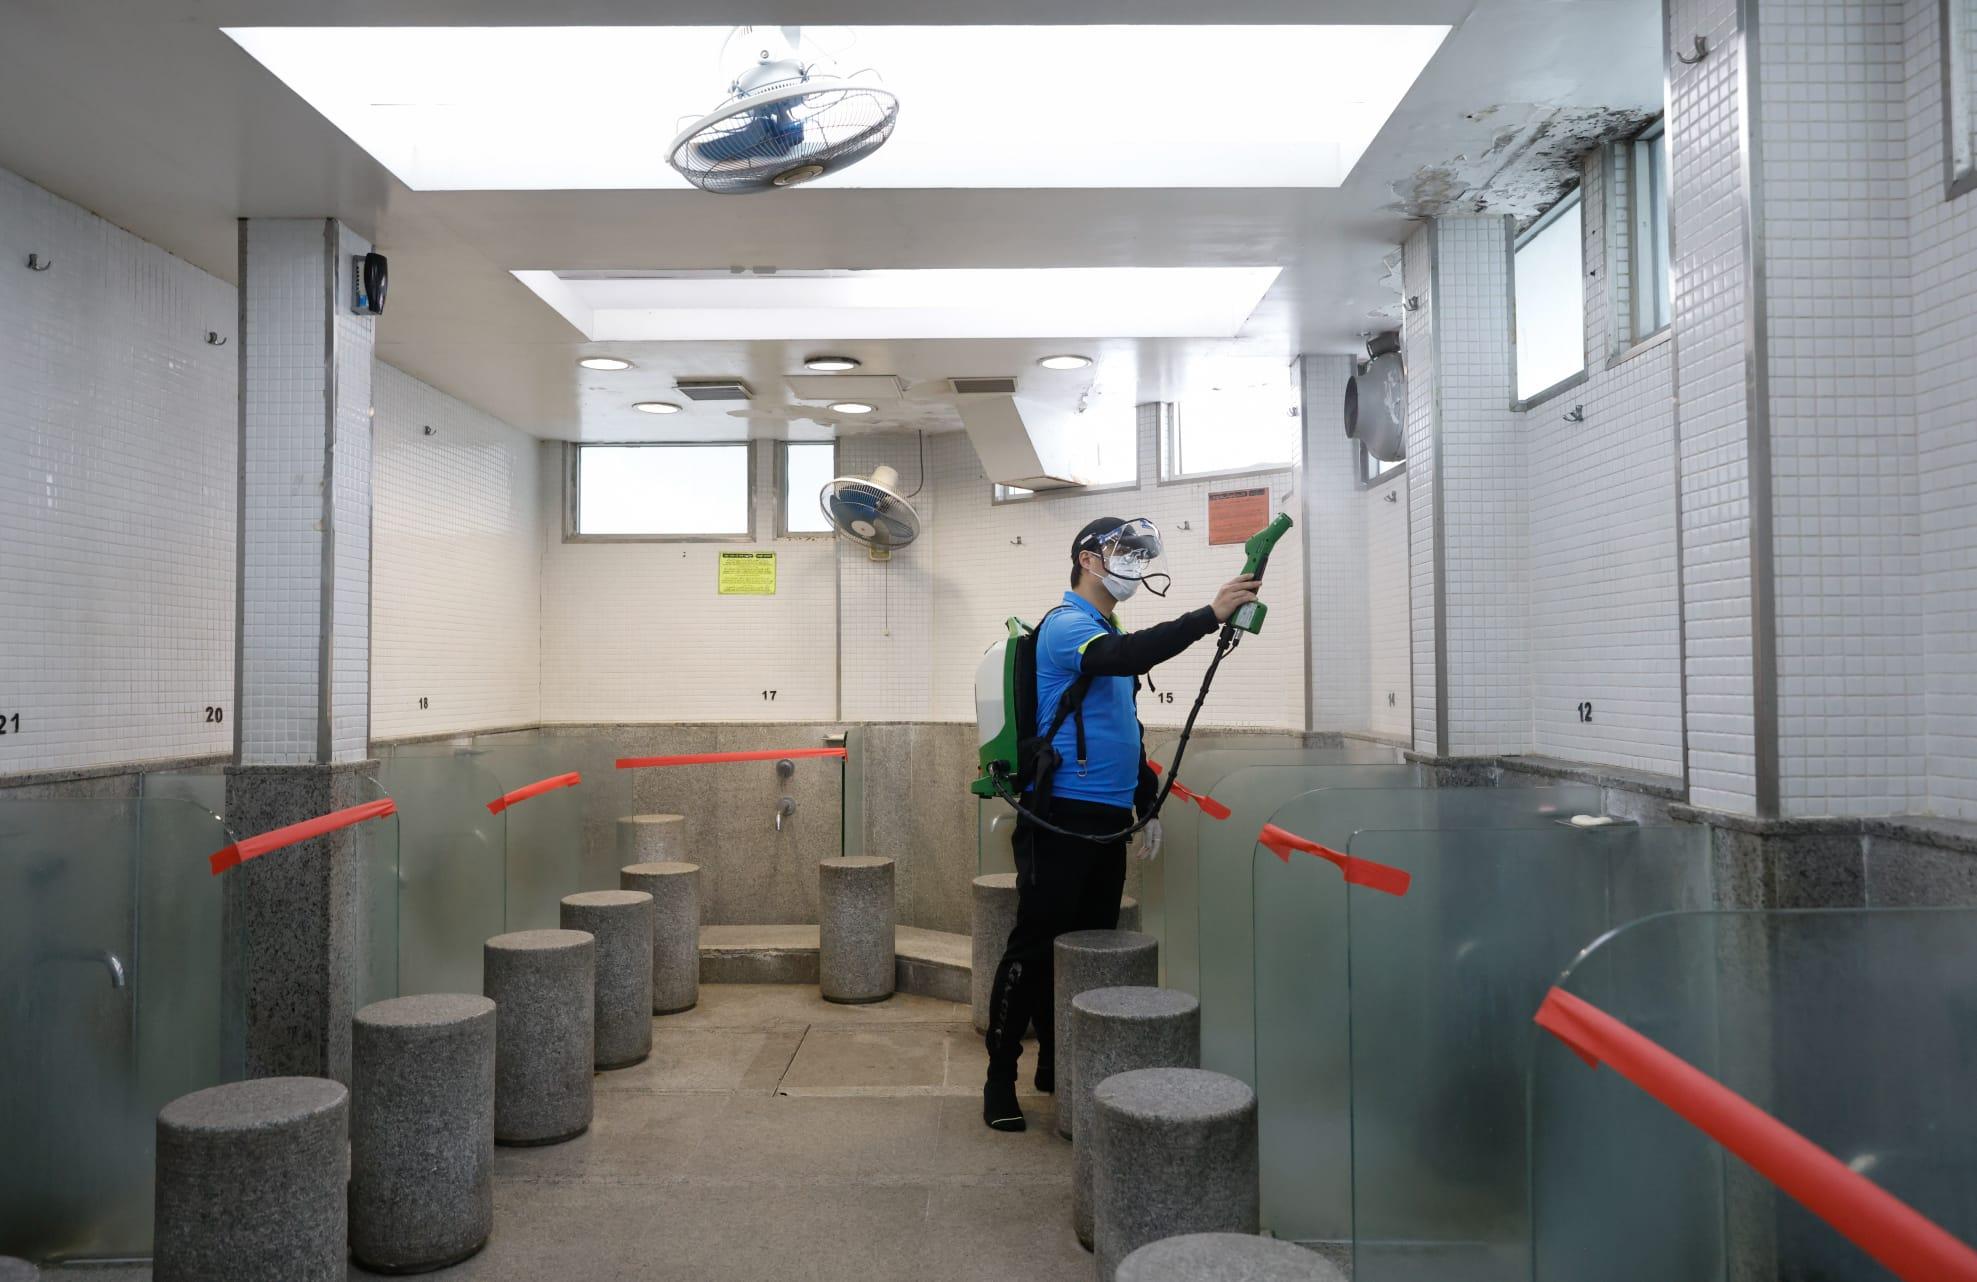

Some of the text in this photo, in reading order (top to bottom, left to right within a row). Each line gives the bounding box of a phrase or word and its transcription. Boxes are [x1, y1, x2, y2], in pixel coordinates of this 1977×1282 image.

[761, 690, 777, 701] 17
[1158, 692, 1173, 703] 15
[418, 697, 429, 710] 18
[205, 706, 223, 723] 20
[1577, 702, 1593, 723] 12
